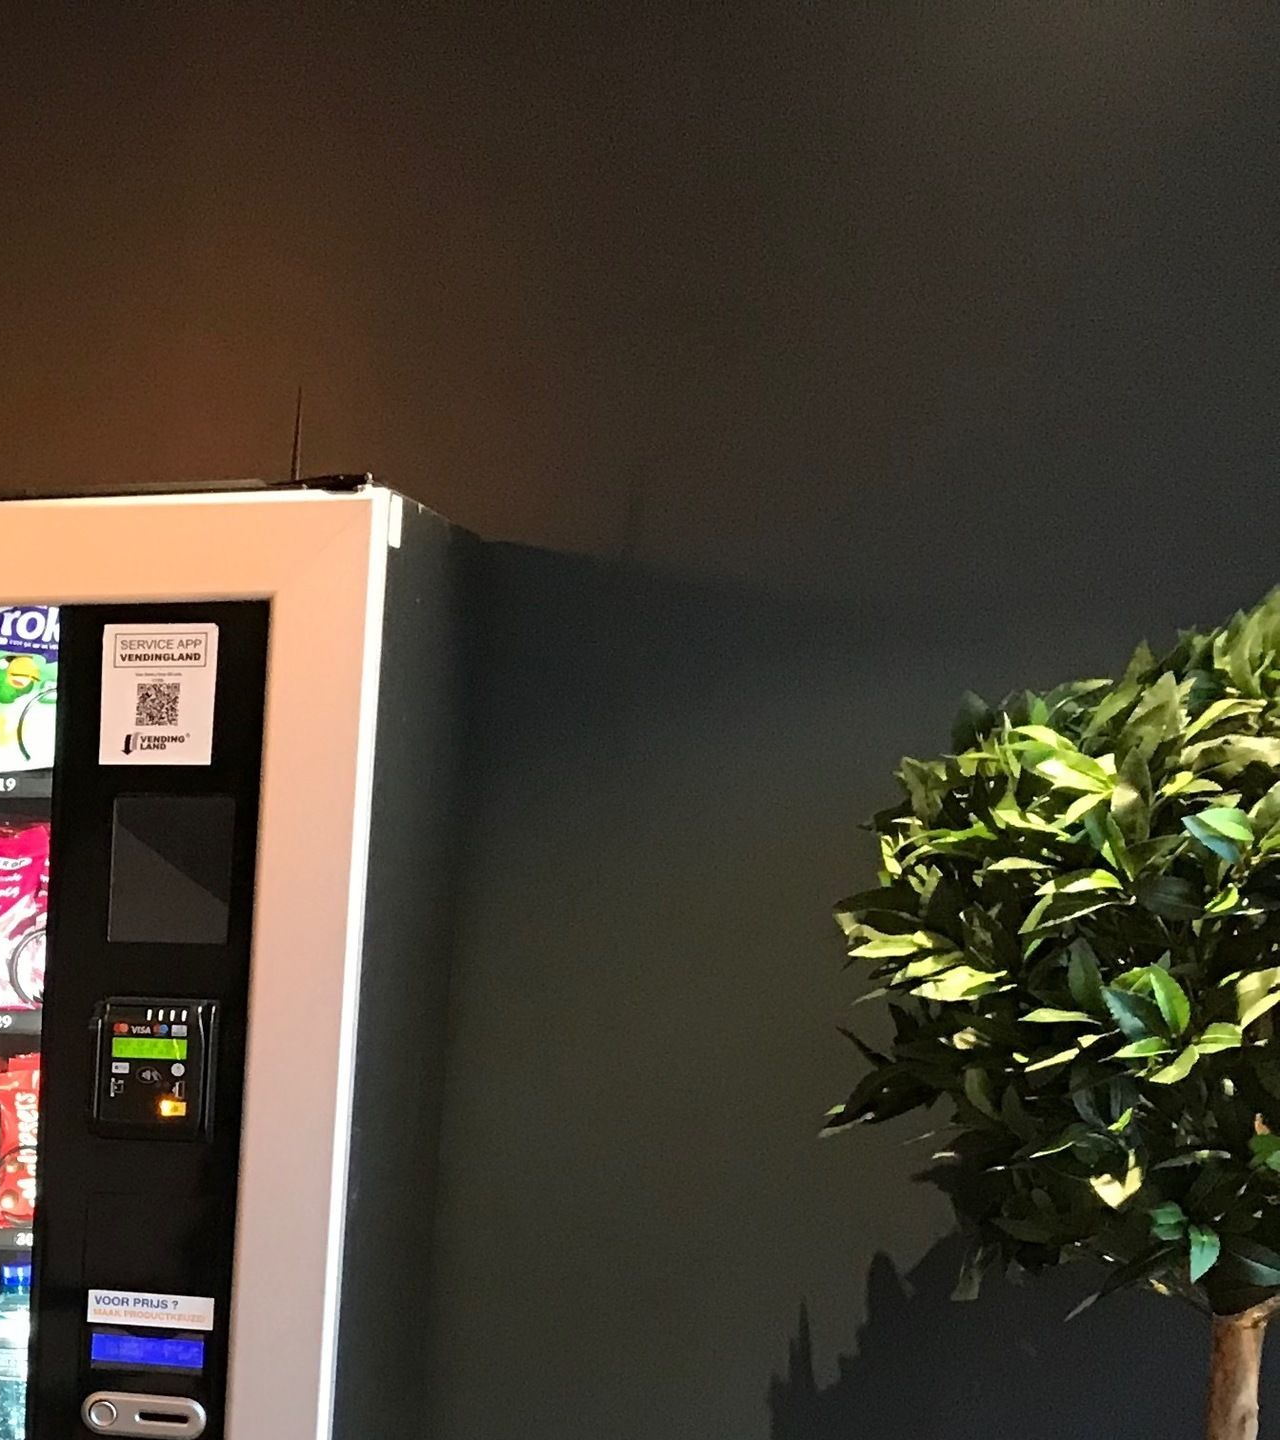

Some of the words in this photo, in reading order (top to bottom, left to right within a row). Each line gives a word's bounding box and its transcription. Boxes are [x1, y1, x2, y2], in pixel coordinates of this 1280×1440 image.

[120, 639, 173, 651] SERVICE
[177, 638, 202, 650] APP
[119, 652, 201, 662] VENDINGLAND
[140, 735, 186, 744] VENDING
[140, 743, 167, 751] LAND
[131, 1025, 152, 1035] VISA
[94, 1295, 129, 1307] VOOR
[133, 1297, 169, 1310] PRIJS
[172, 1300, 179, 1310] ?
[93, 1308, 122, 1318] MAAK
